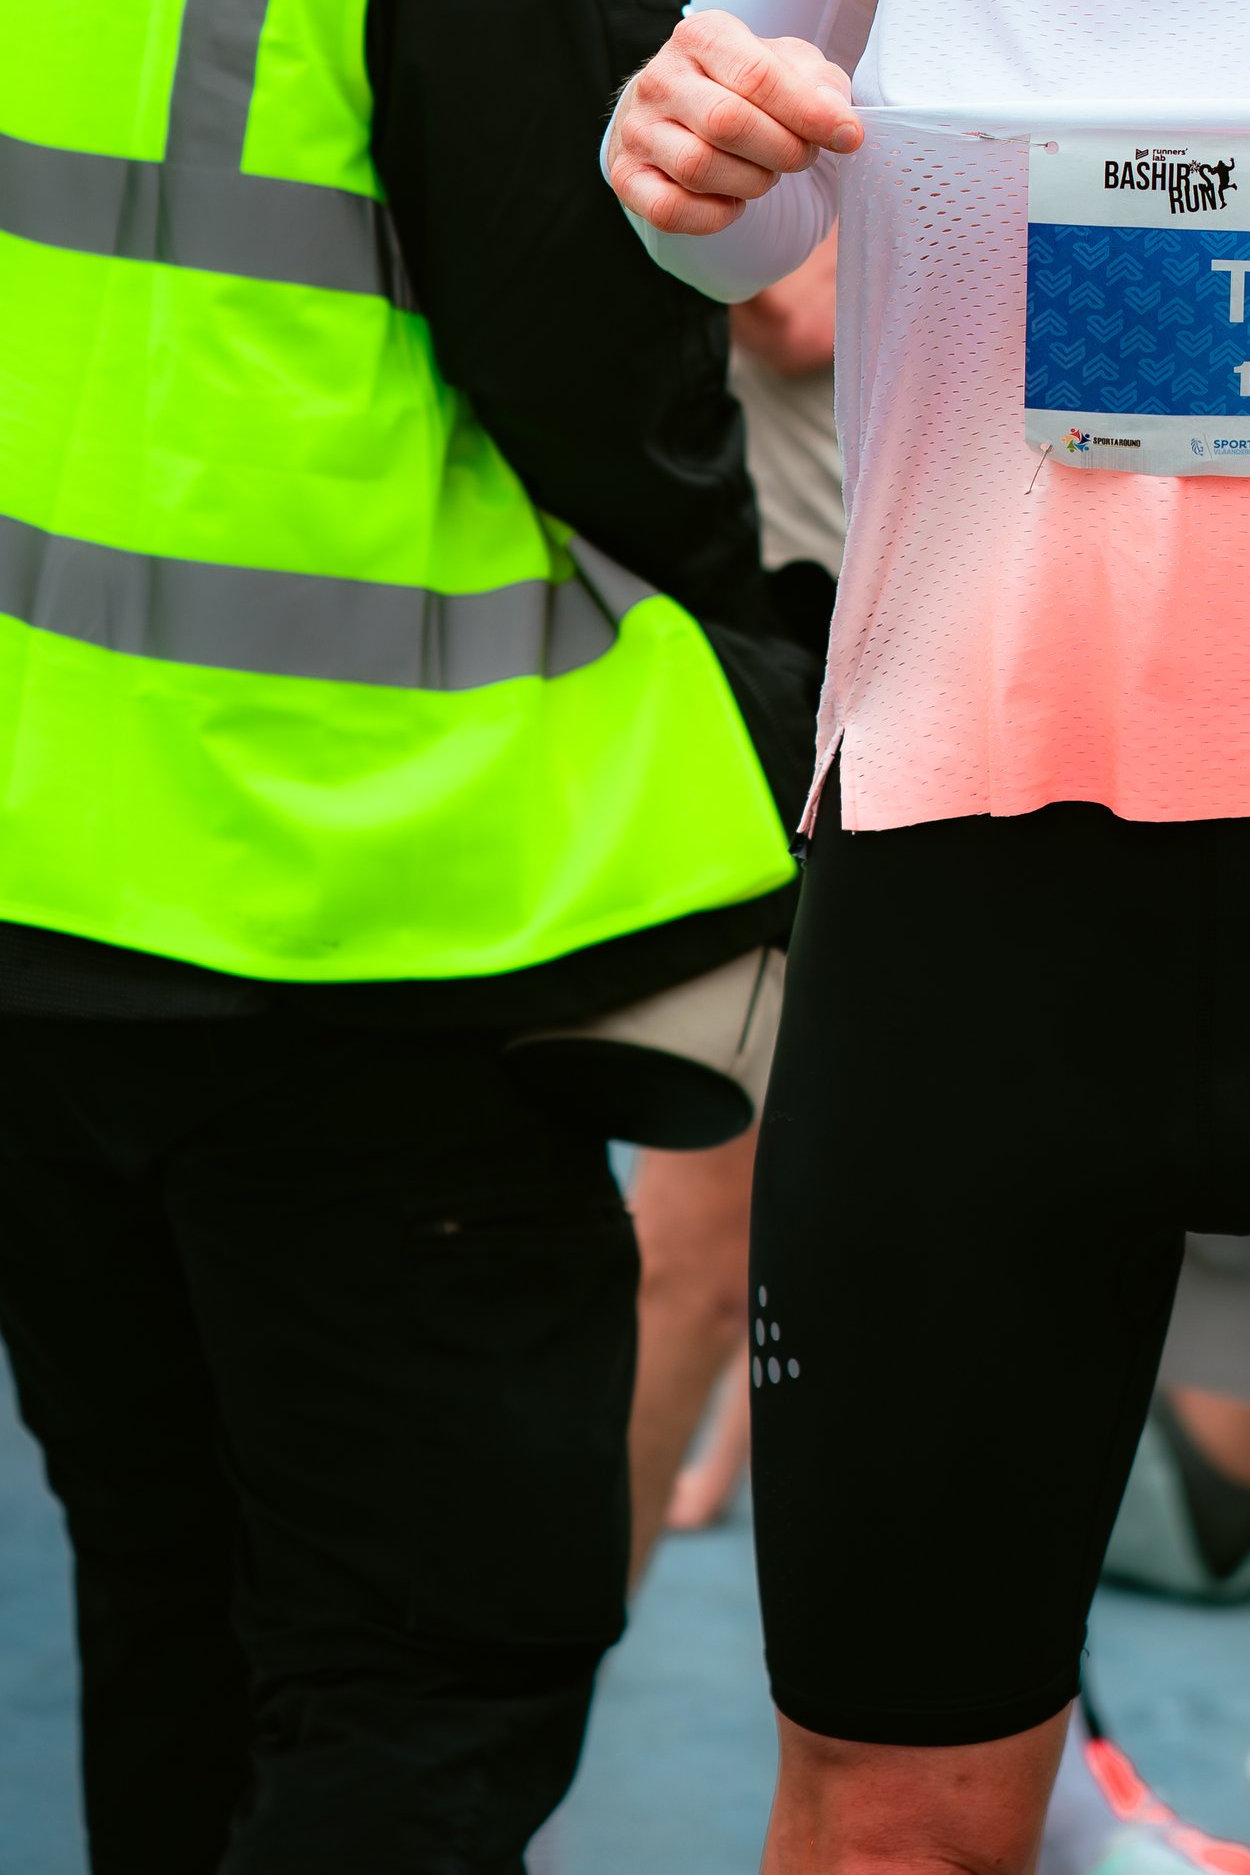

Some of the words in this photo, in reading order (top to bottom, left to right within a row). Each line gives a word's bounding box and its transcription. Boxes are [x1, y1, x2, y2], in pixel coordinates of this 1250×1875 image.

[1152, 148, 1188, 156] runners'
[1152, 154, 1167, 162] lab
[1169, 183, 1218, 214] RUN
[1093, 436, 1141, 448] SPORTAROUND
